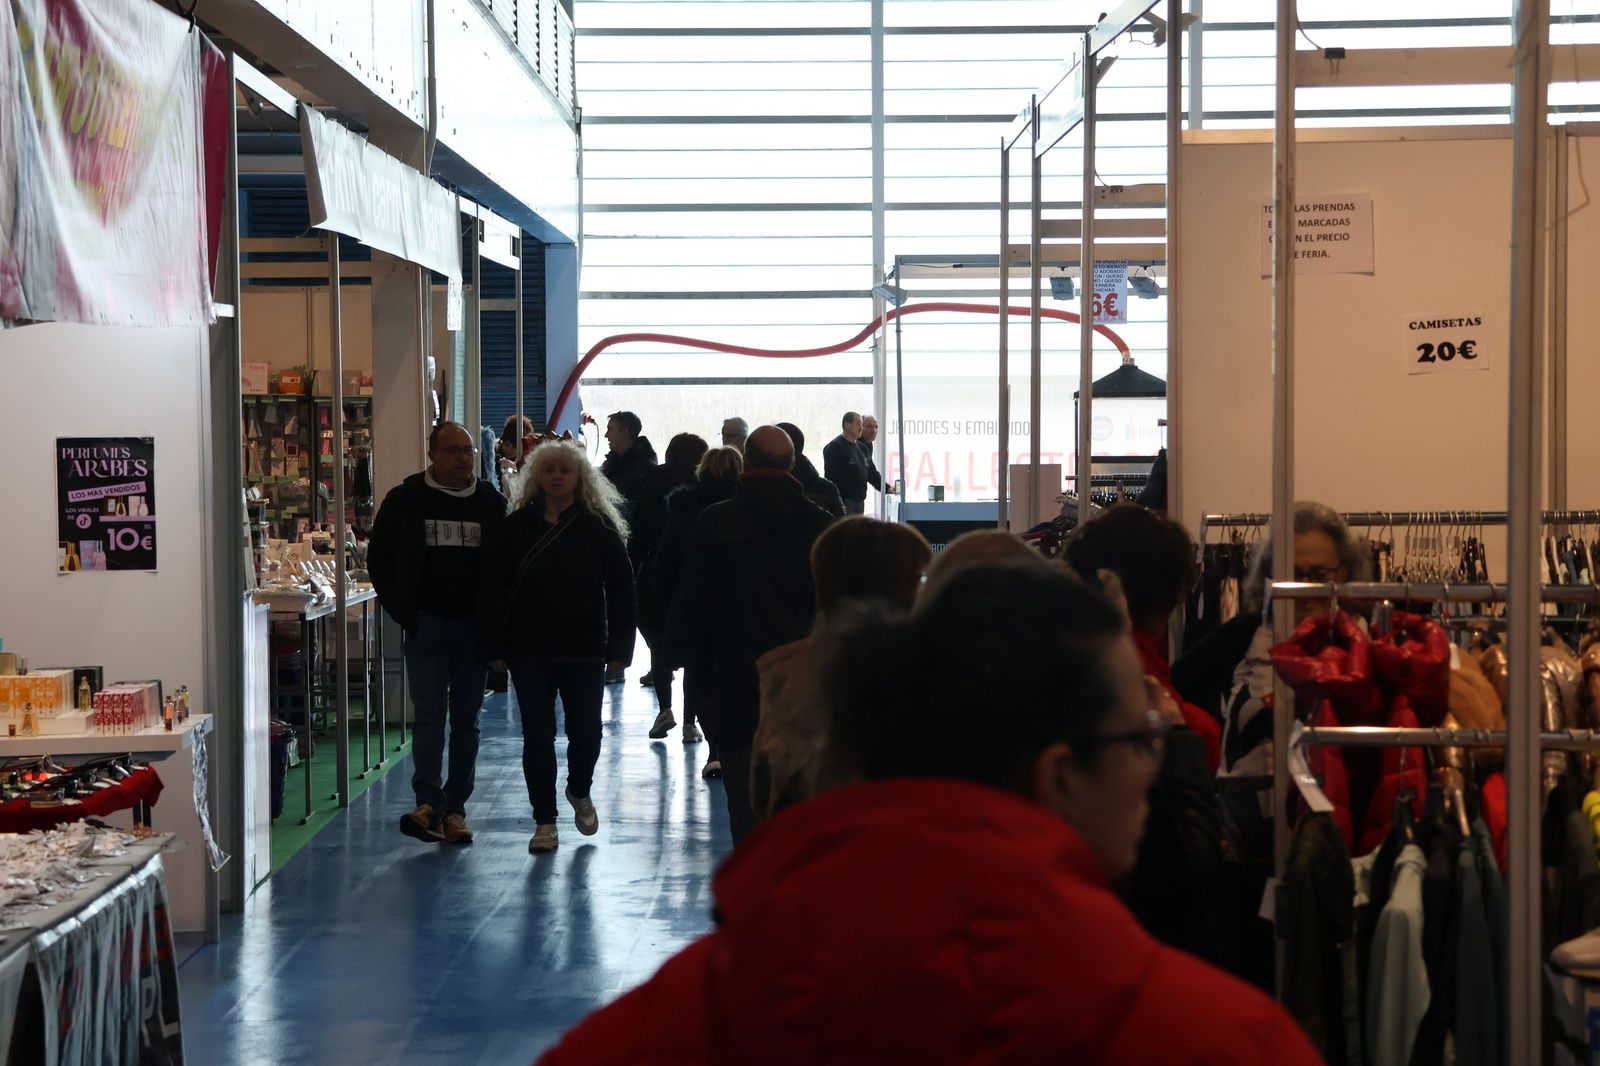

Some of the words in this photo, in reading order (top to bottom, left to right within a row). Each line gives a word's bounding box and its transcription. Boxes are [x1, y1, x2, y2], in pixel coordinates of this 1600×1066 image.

[1294, 204, 1311, 213] LAS
[1312, 202, 1356, 212] PRENDAS
[1298, 217, 1351, 228] MARCADAS
[1304, 234, 1314, 243] EL
[1316, 233, 1350, 242] PRECIO
[1302, 250, 1330, 259] FERIA.
[1092, 292, 1119, 317] 6€
[1408, 317, 1482, 330] CAMISETAS
[1416, 340, 1478, 363] 20€
[953, 420, 961, 436] Y
[965, 420, 1031, 436] EMBIDO
[62, 446, 131, 459] PERFUMES
[69, 459, 149, 478] ARABES
[71, 491, 86, 499] LOS
[104, 484, 141, 495] VENDIDOS
[107, 527, 153, 551] 10€
